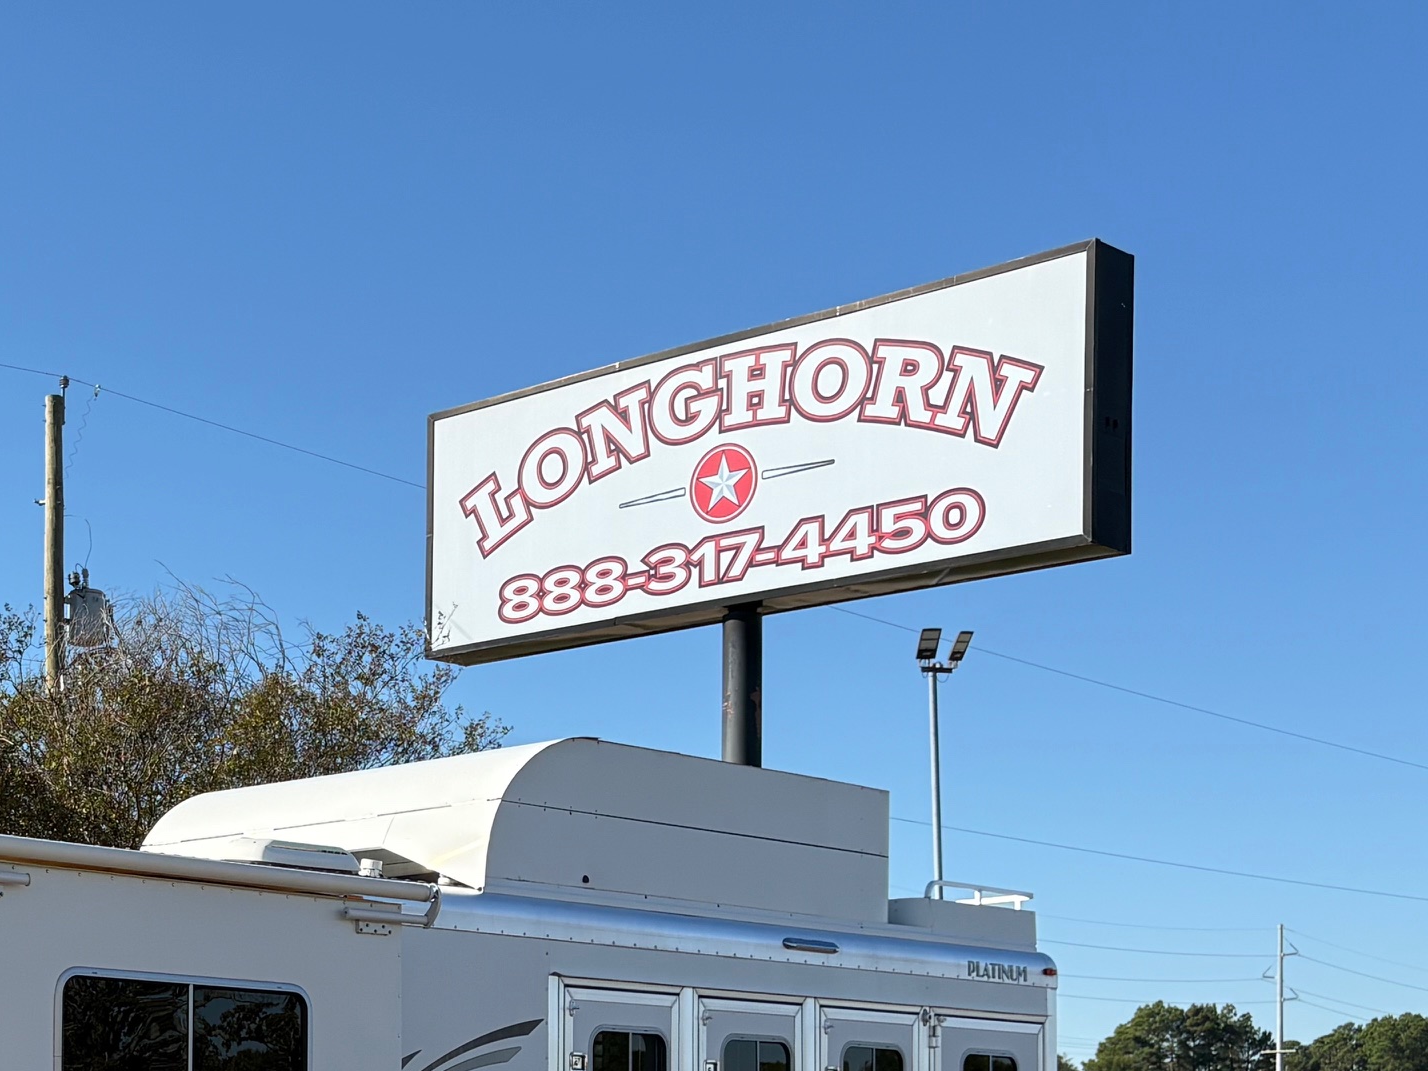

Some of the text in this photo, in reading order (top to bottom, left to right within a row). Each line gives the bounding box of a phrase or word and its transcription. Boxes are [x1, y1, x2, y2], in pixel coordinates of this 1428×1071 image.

[459, 338, 1045, 558] LONGHORN
[498, 487, 987, 624] 888-317-4450
[967, 960, 1028, 983] PLATINUM
